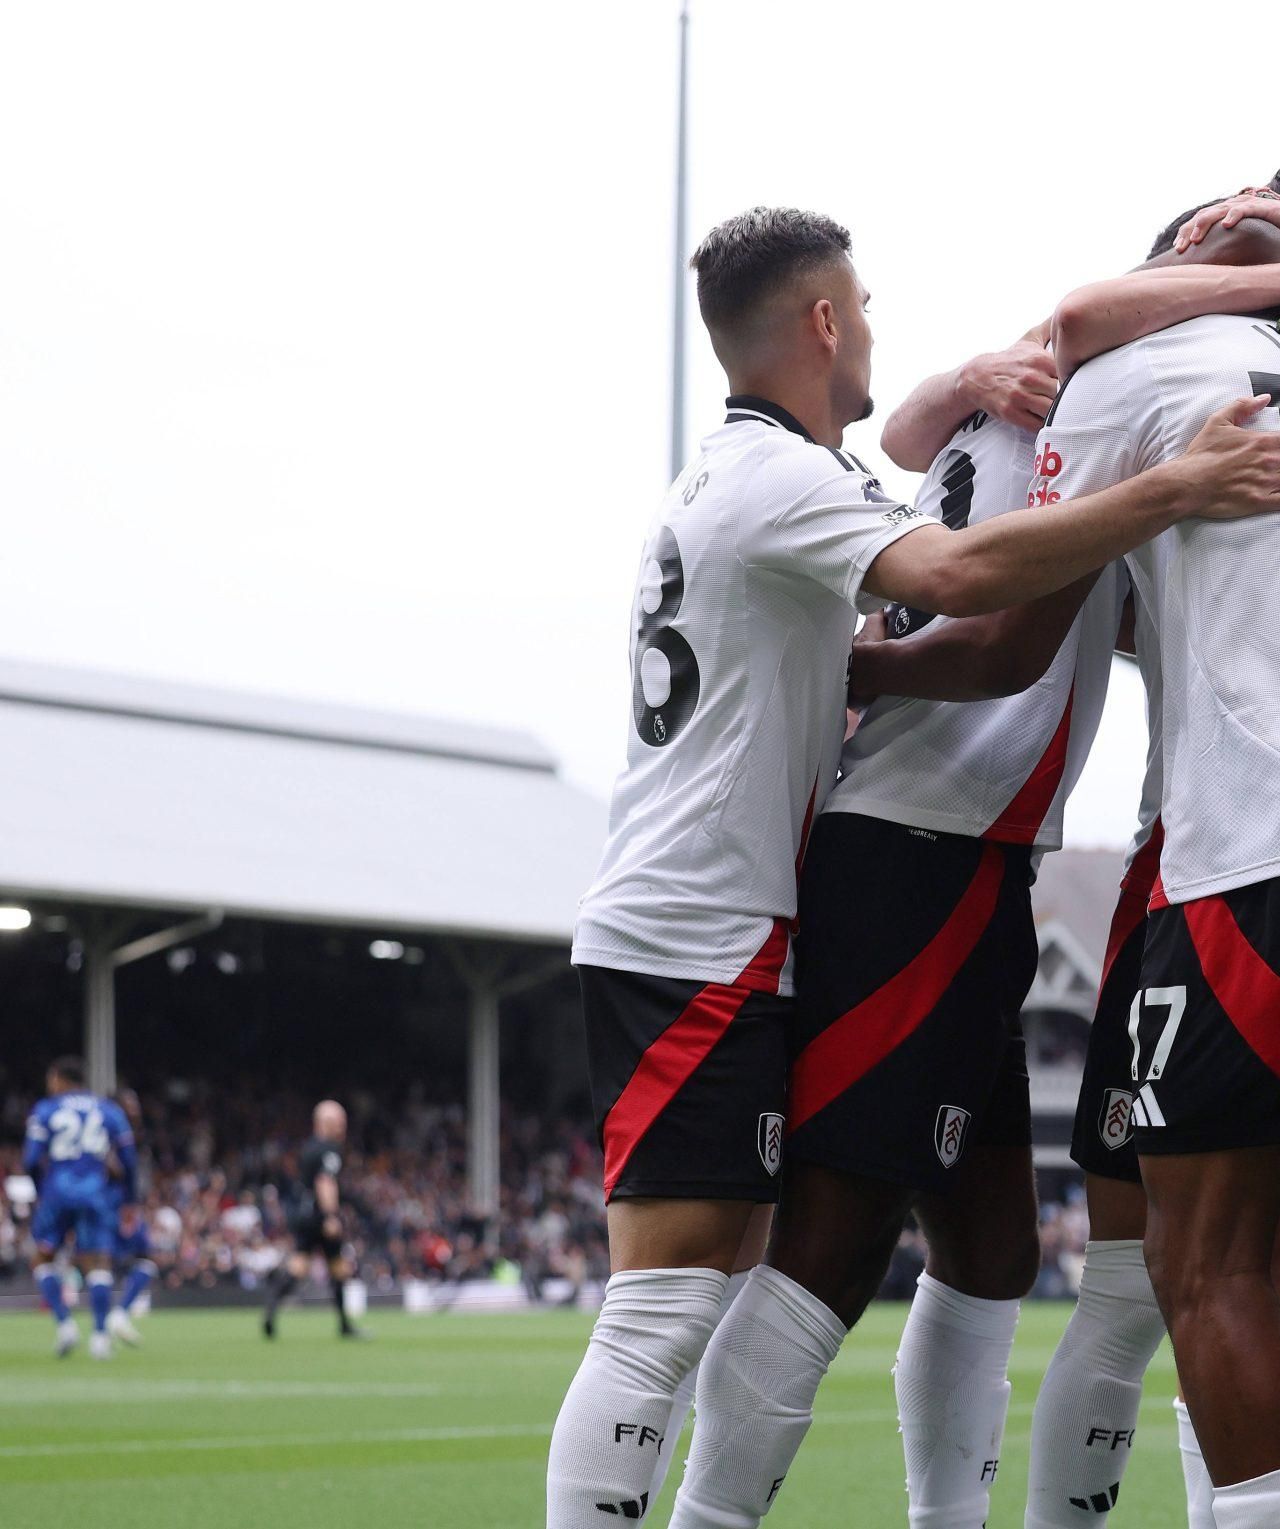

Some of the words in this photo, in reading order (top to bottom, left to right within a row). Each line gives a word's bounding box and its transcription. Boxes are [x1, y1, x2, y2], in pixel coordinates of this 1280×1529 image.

[1127, 985, 1187, 1081] 17
[49, 1108, 110, 1161] 24
[1106, 1098, 1129, 1138] FFC
[615, 1423, 664, 1455] FF
